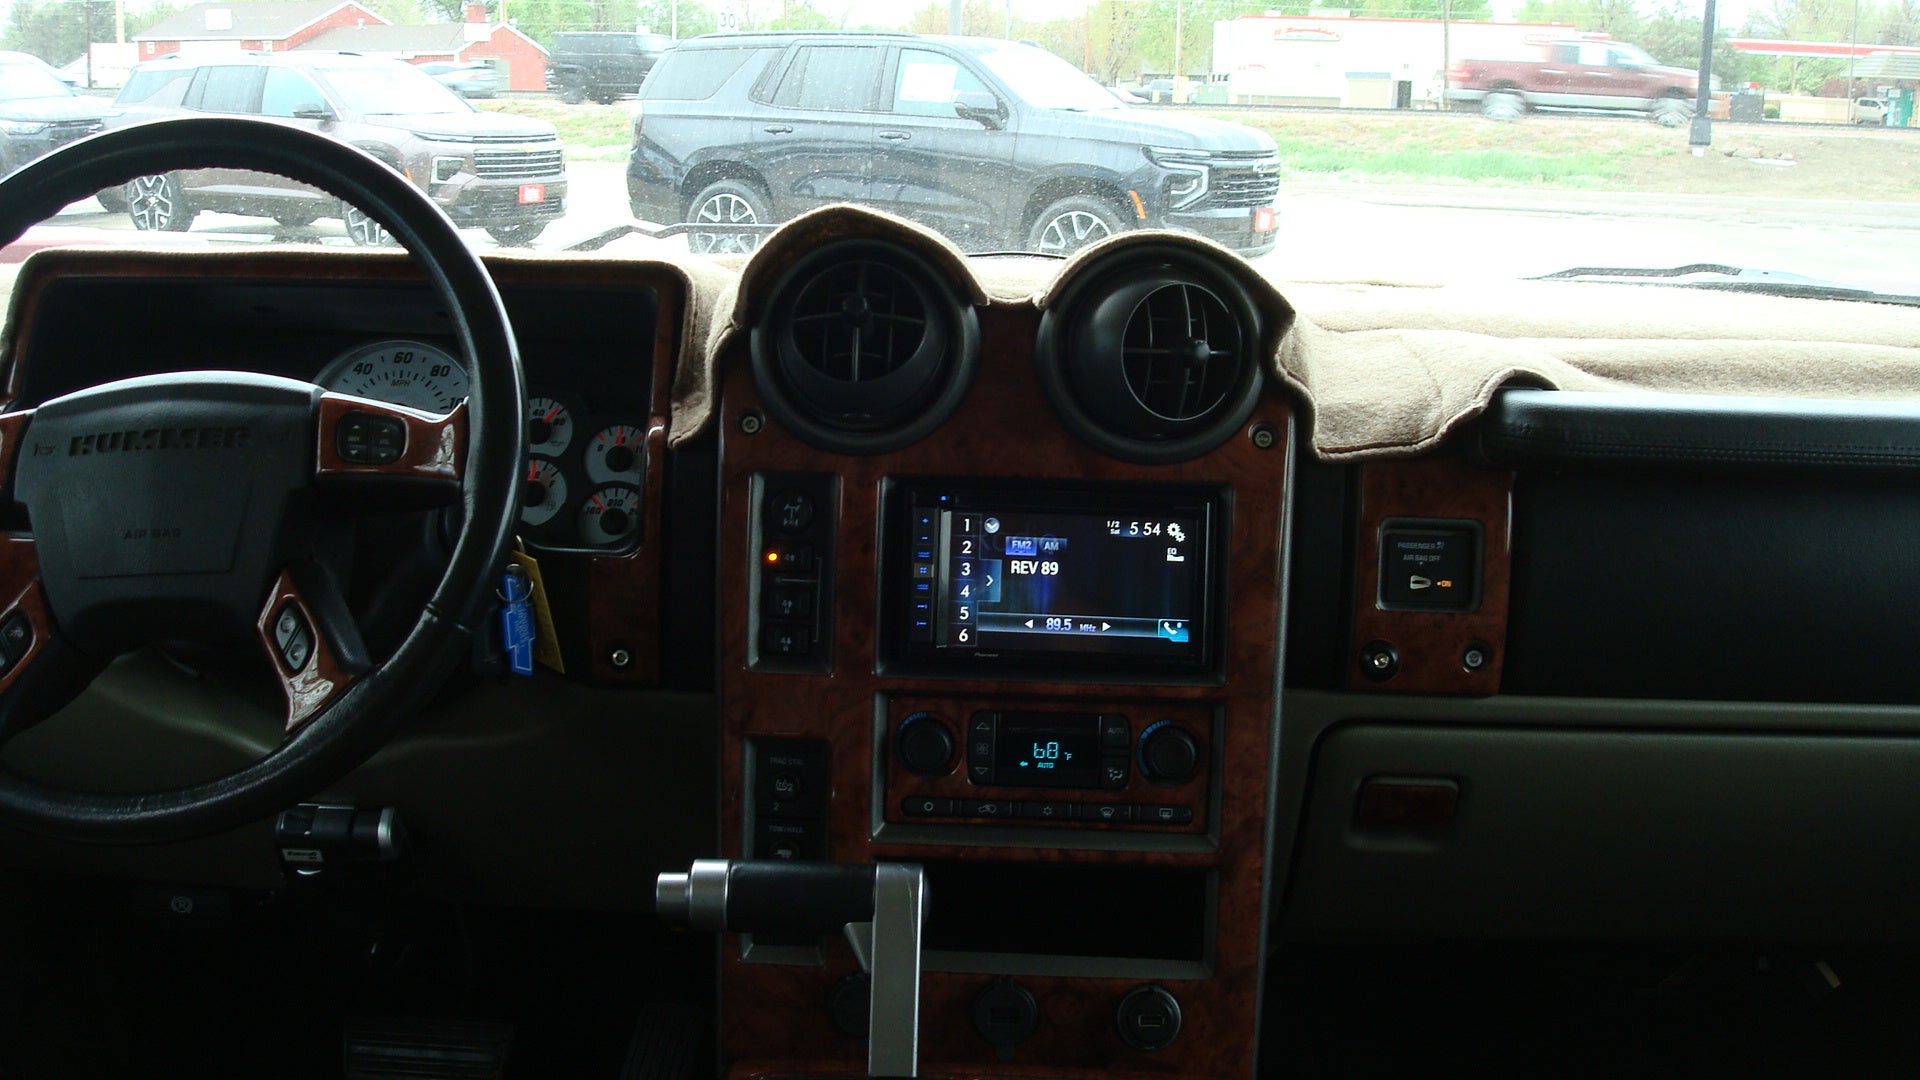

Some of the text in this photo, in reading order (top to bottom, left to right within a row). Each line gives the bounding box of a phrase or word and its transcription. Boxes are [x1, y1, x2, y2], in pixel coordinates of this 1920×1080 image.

[720, 12, 735, 28] 30
[393, 351, 414, 364] 60
[353, 362, 374, 375] 40
[430, 364, 451, 377] 80
[391, 379, 411, 387] MPH
[68, 426, 251, 457] HUMMER
[964, 518, 970, 532] 1
[1106, 520, 1121, 528] 1/2
[123, 527, 181, 540] AIR BAG
[961, 540, 972, 554] 2
[1012, 540, 1032, 549] FM2
[1044, 541, 1059, 551] AM
[961, 562, 971, 576] 3
[1010, 559, 1059, 576] REV 89
[960, 584, 970, 598] 4
[959, 606, 969, 620] 5
[1045, 617, 1097, 633] 89.5 MHz
[958, 628, 969, 642] 6
[1107, 727, 1125, 735] AUTO
[1033, 741, 1059, 760] 68
